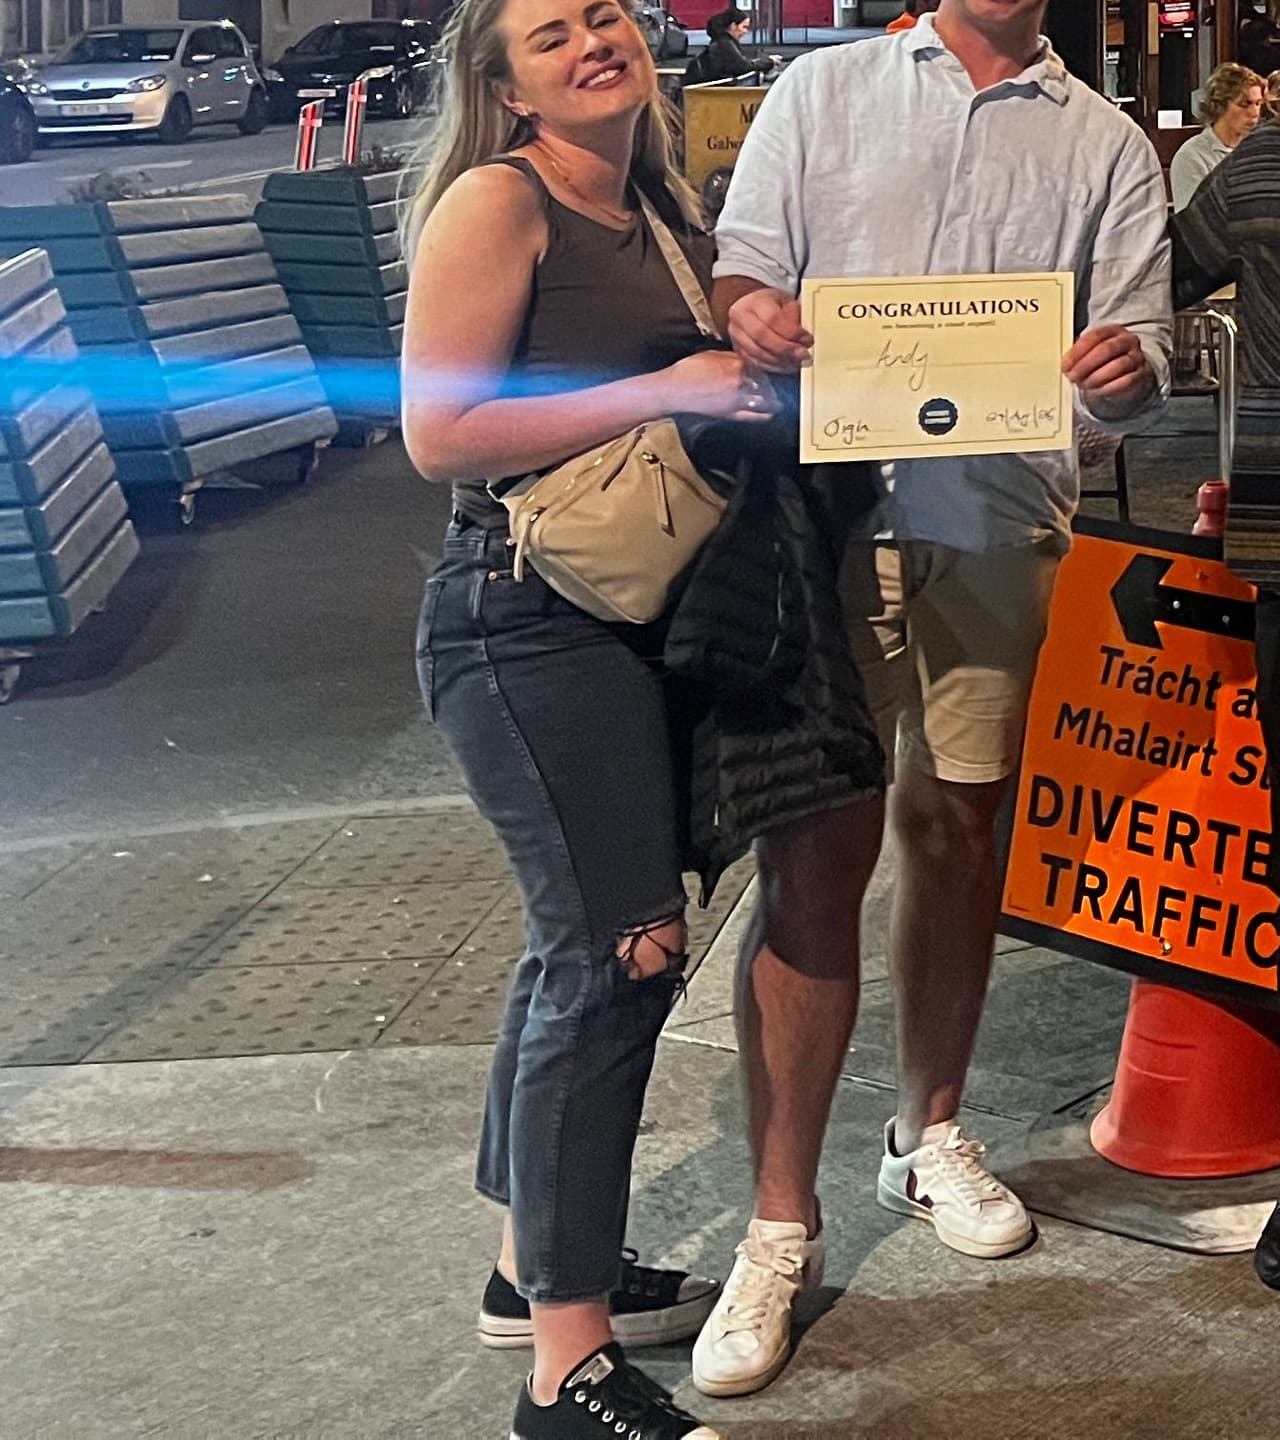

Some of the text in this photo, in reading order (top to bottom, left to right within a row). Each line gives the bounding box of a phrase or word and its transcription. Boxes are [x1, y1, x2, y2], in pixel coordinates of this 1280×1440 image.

[838, 298, 1040, 319] CONGRATULATIONS
[1100, 643, 1222, 711] Trácht
[1053, 701, 1217, 778] Mhalairt
[1027, 775, 1273, 888] DIVERTE
